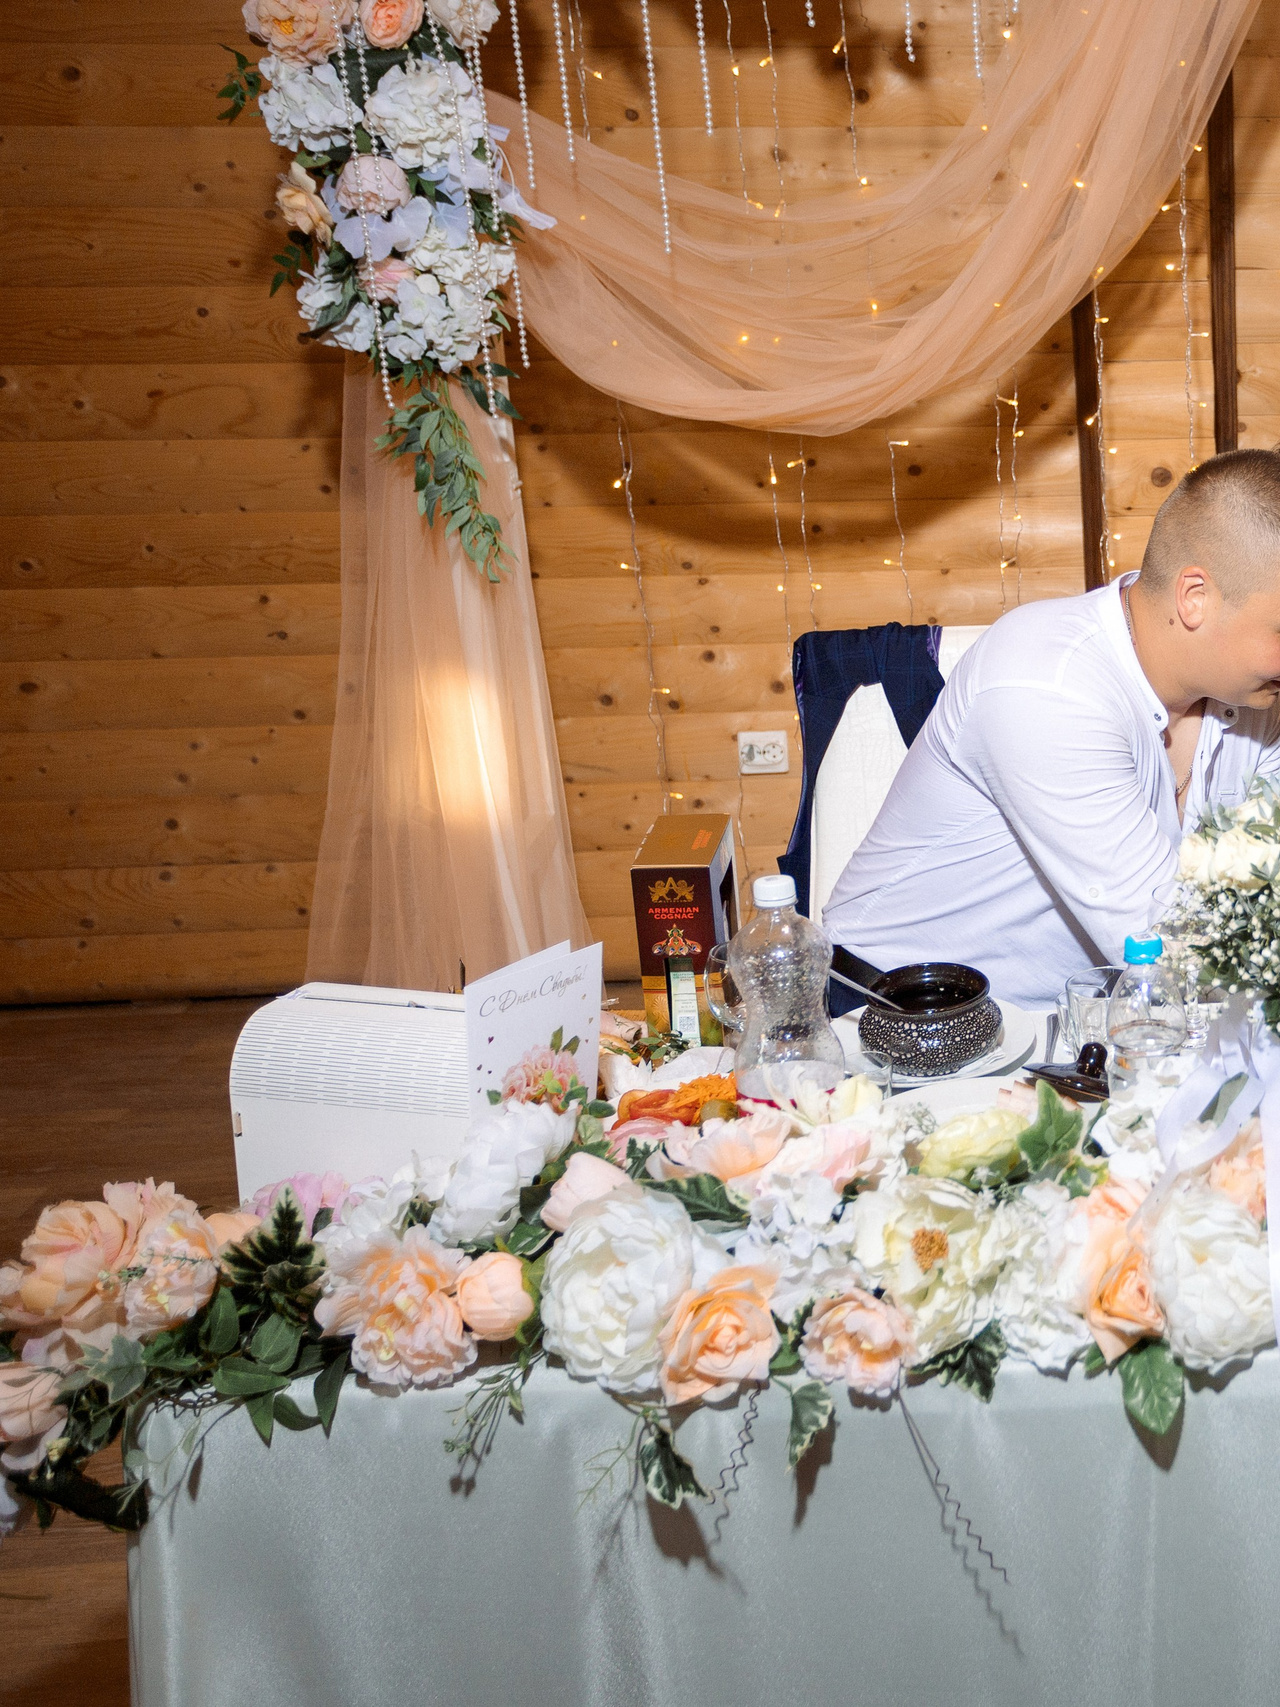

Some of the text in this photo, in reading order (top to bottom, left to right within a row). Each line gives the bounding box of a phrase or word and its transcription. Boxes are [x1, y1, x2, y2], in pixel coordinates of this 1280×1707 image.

[648, 906, 699, 914] ARMENIAN
[479, 995, 496, 1018] С
[539, 964, 588, 997] Свадьбы!
